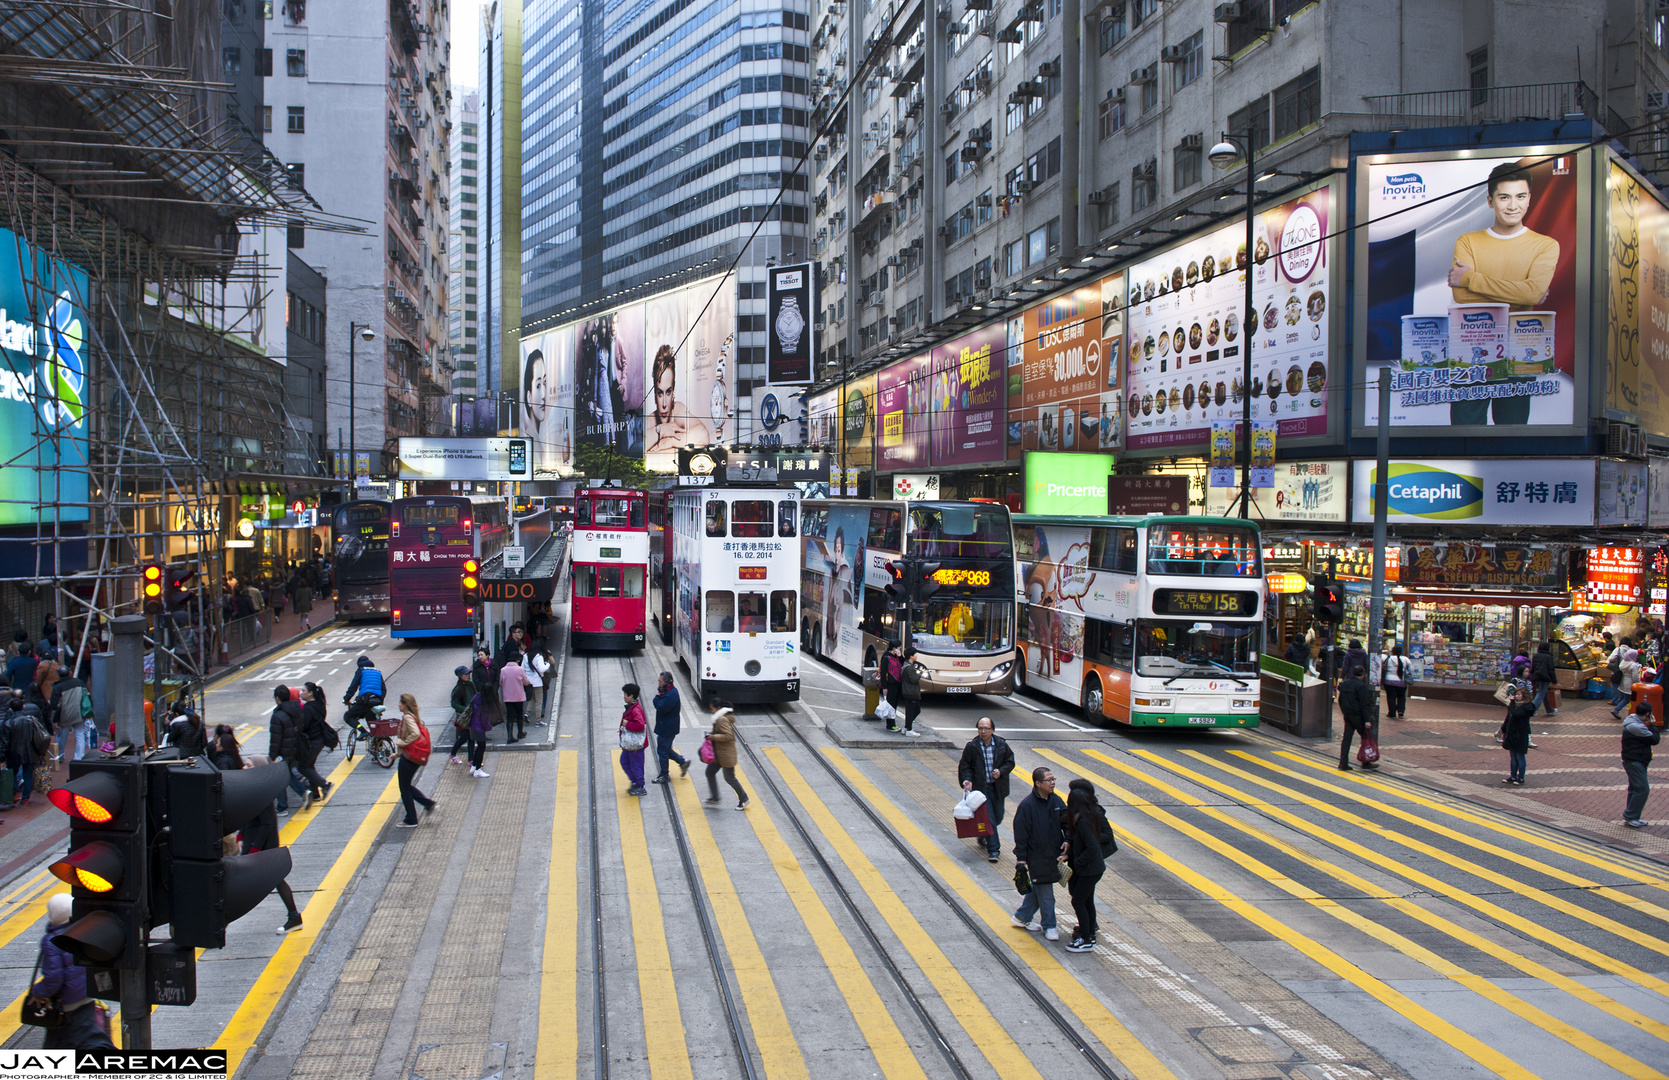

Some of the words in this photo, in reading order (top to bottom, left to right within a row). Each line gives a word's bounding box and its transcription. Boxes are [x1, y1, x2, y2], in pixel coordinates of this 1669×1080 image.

[1404, 176, 1417, 184] petit
[1383, 184, 1426, 194] Inovital
[1290, 258, 1309, 271] Dining
[1046, 326, 1062, 348] DSC
[1441, 347, 1447, 358] 1
[1496, 344, 1504, 358] 2
[1545, 345, 1551, 357] 3
[1024, 358, 1046, 383] 皇室堡
[1054, 346, 1083, 382] 30,000
[586, 420, 630, 435] BURBERRY
[1282, 424, 1297, 432] TheONE
[758, 433, 781, 446] SOGO
[782, 460, 820, 471] 謝瑞麟
[686, 476, 707, 485] 137
[742, 468, 762, 480] 57
[1047, 483, 1106, 497] Pricerite
[1390, 484, 1462, 503] Cetaphil
[1496, 481, 1578, 504] 舒特膚
[428, 533, 435, 542] 5
[723, 542, 782, 551] 渣打香港馬拉松
[393, 551, 430, 562] 周大福
[1589, 548, 1644, 562] 新昌大藥房
[874, 554, 890, 570] SEIK
[968, 570, 990, 585] 968
[1419, 571, 1436, 580] SUN
[1444, 572, 1479, 582] CHEUNG
[1487, 573, 1545, 584] DISPENSARY
[480, 583, 534, 598] MIDO
[1174, 593, 1198, 603] 天后
[1215, 594, 1238, 610] 15B
[325, 628, 385, 636] BUS
[304, 634, 380, 646] STOP
[272, 649, 347, 664] 巴士
[244, 664, 318, 682] 站
[787, 682, 797, 690] 57
